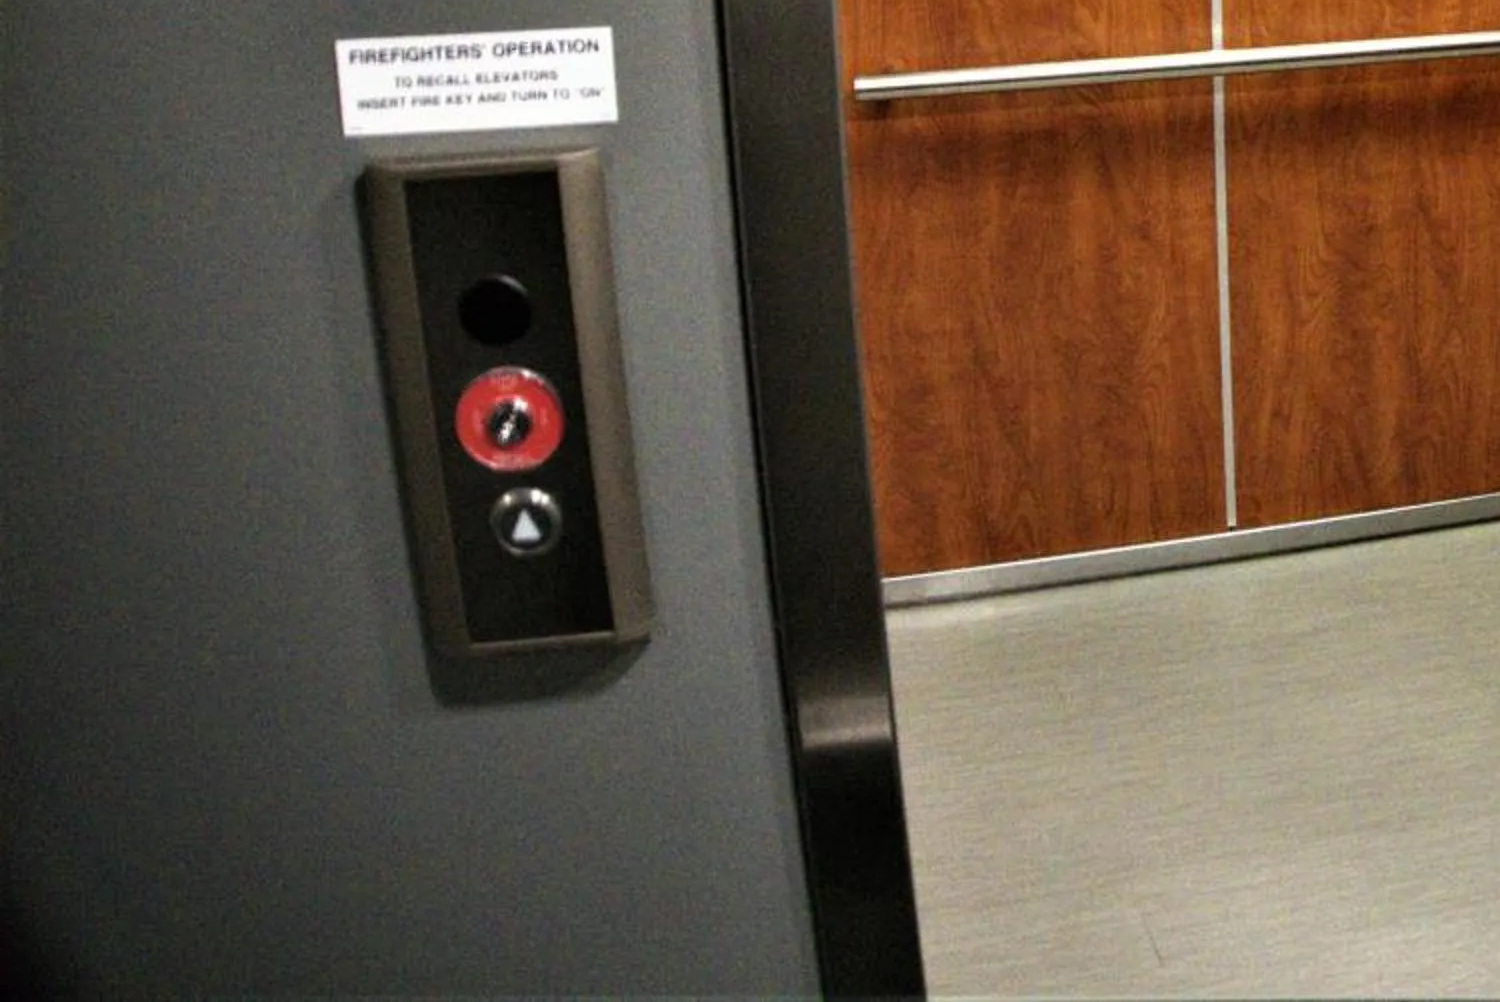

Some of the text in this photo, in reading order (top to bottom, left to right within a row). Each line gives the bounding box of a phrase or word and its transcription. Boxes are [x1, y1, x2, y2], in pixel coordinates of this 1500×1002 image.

[492, 38, 599, 59] OPERATION
[394, 70, 559, 89] TO RECALL ELEVATORS
[357, 96, 405, 110] INSERT
[445, 93, 472, 105] KEY
[477, 91, 506, 104] AND
[511, 89, 548, 102] TURN
[553, 88, 570, 100] TO
